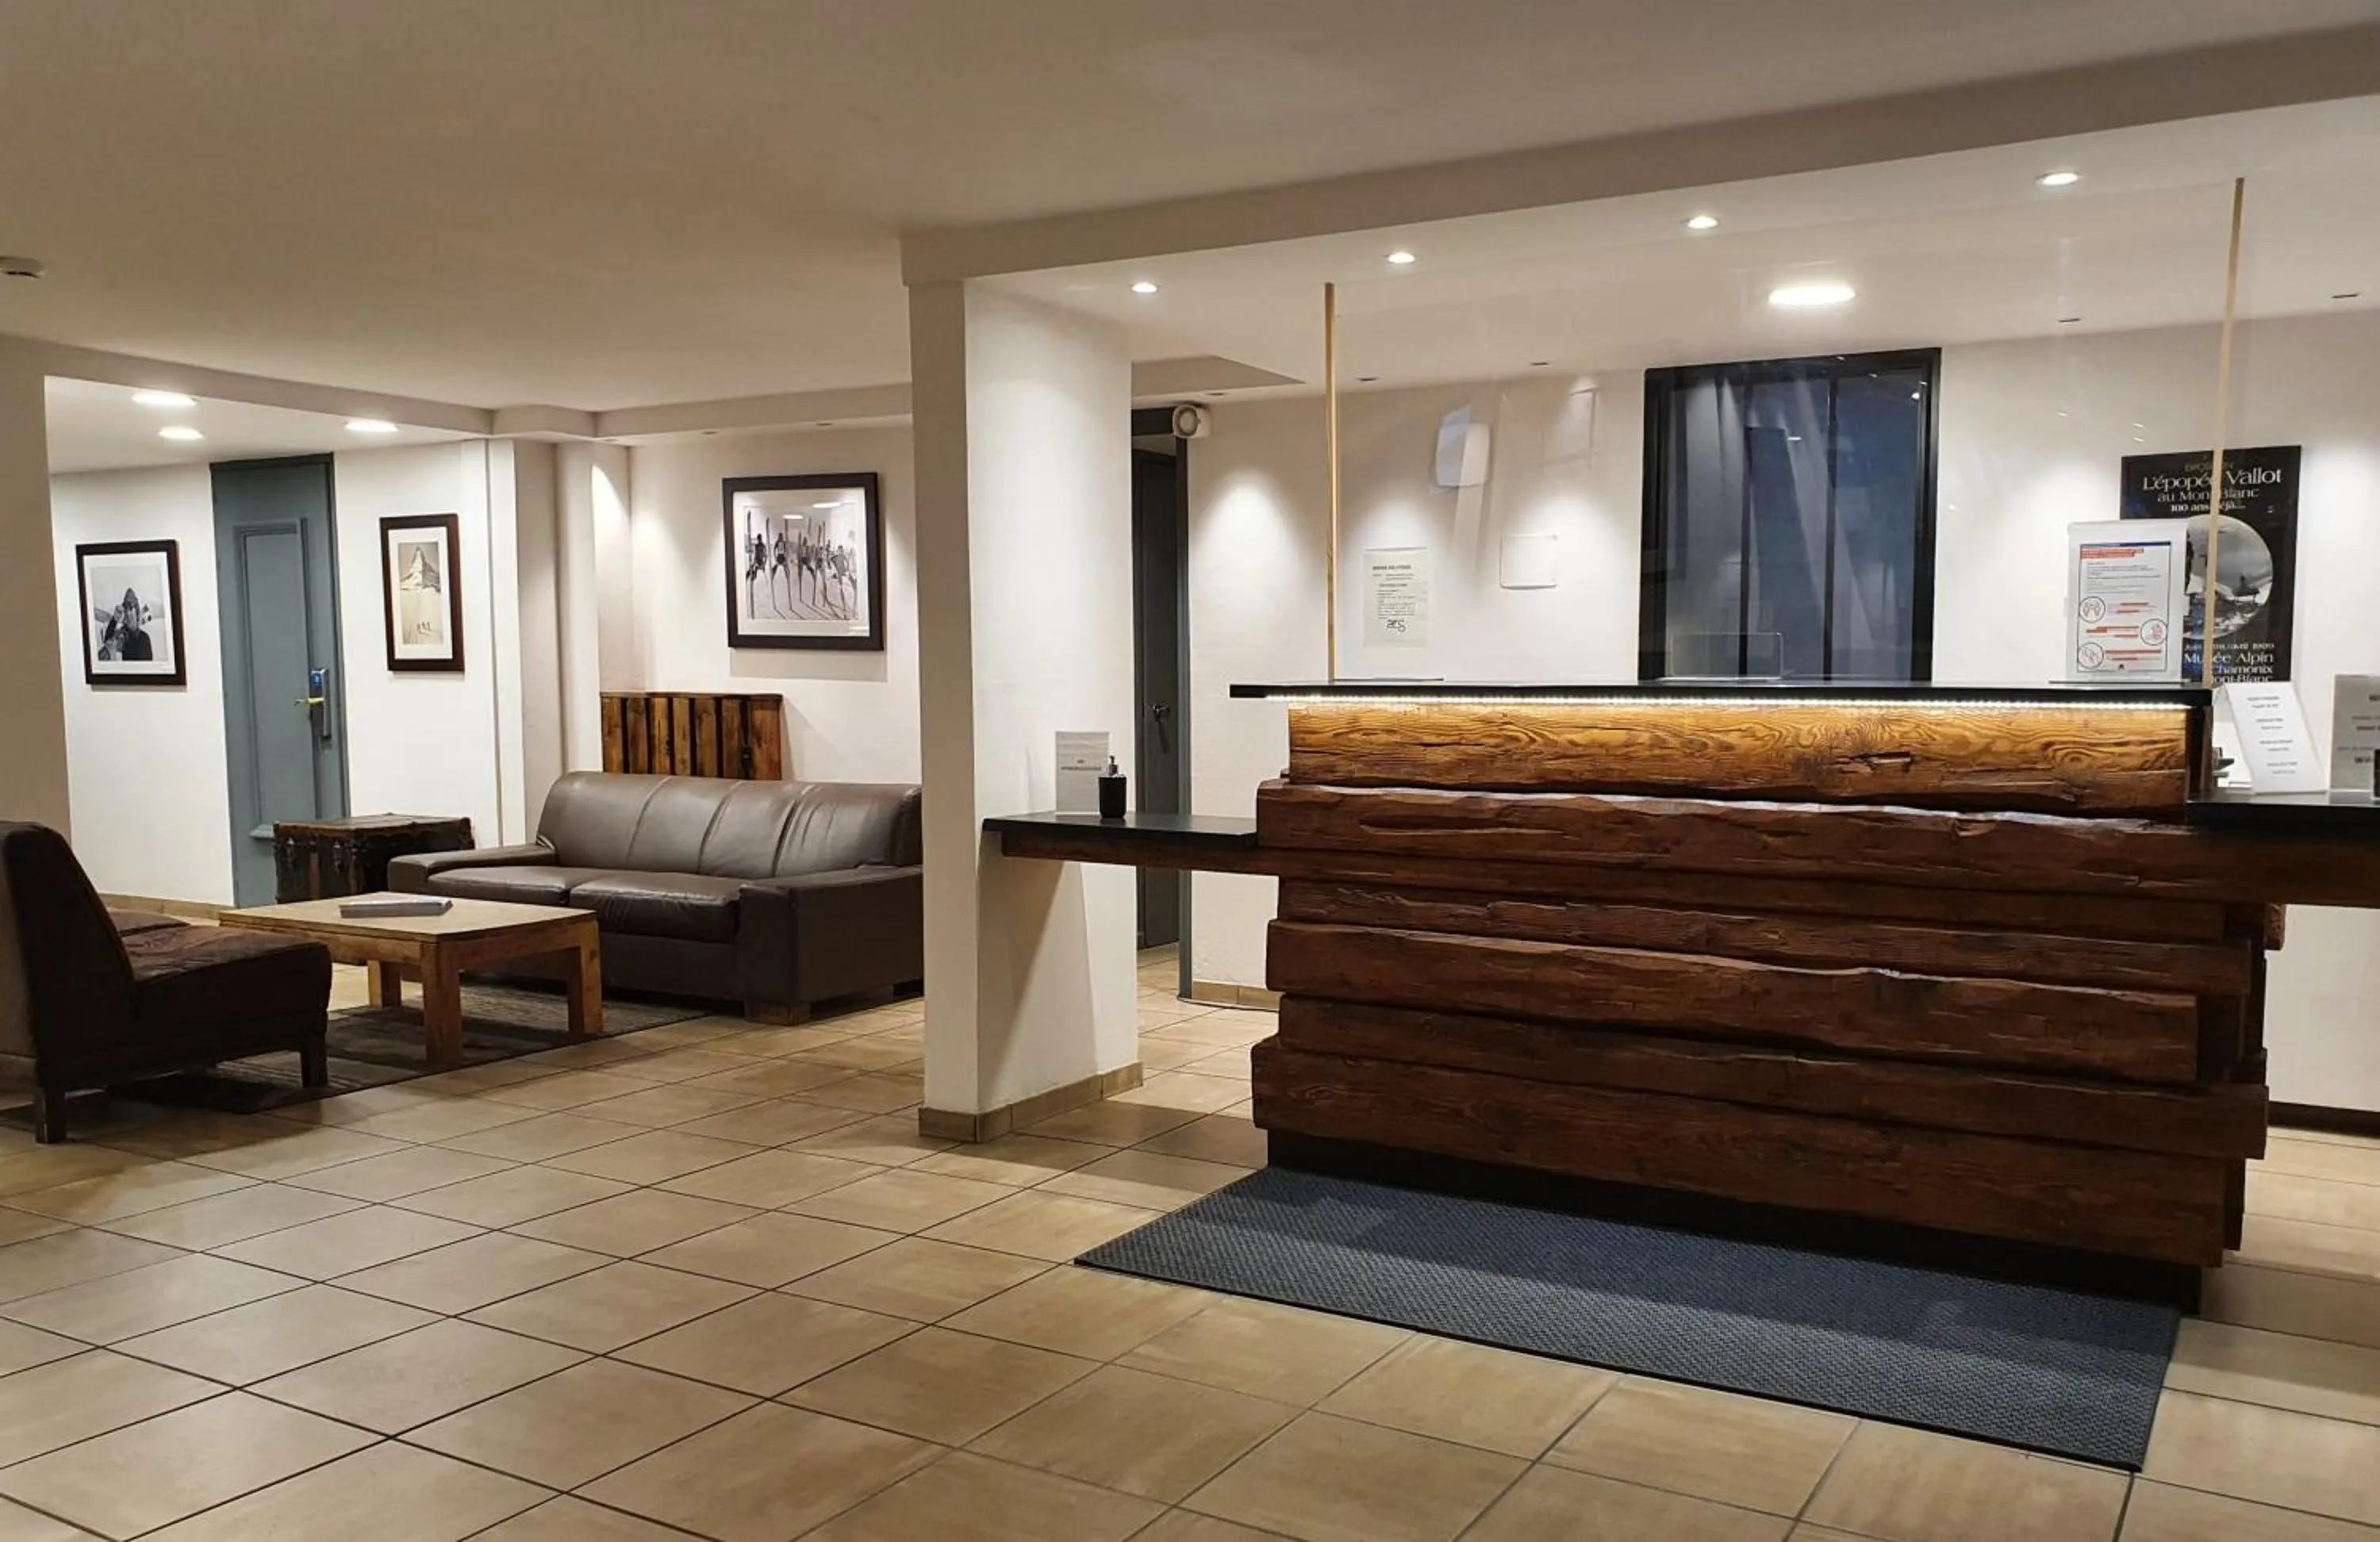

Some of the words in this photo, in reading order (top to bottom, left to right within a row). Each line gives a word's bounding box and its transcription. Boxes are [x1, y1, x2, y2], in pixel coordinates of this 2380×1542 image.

[2143, 472, 2212, 493] L'épopé
[2225, 466, 2282, 485] Vallot
[2157, 492, 2175, 502] au
[2179, 491, 2210, 502] Mon
[2225, 488, 2260, 498] lanc
[2171, 504, 2189, 512] 100
[2183, 651, 2232, 664] Muée
[2236, 650, 2274, 666] Alpin
